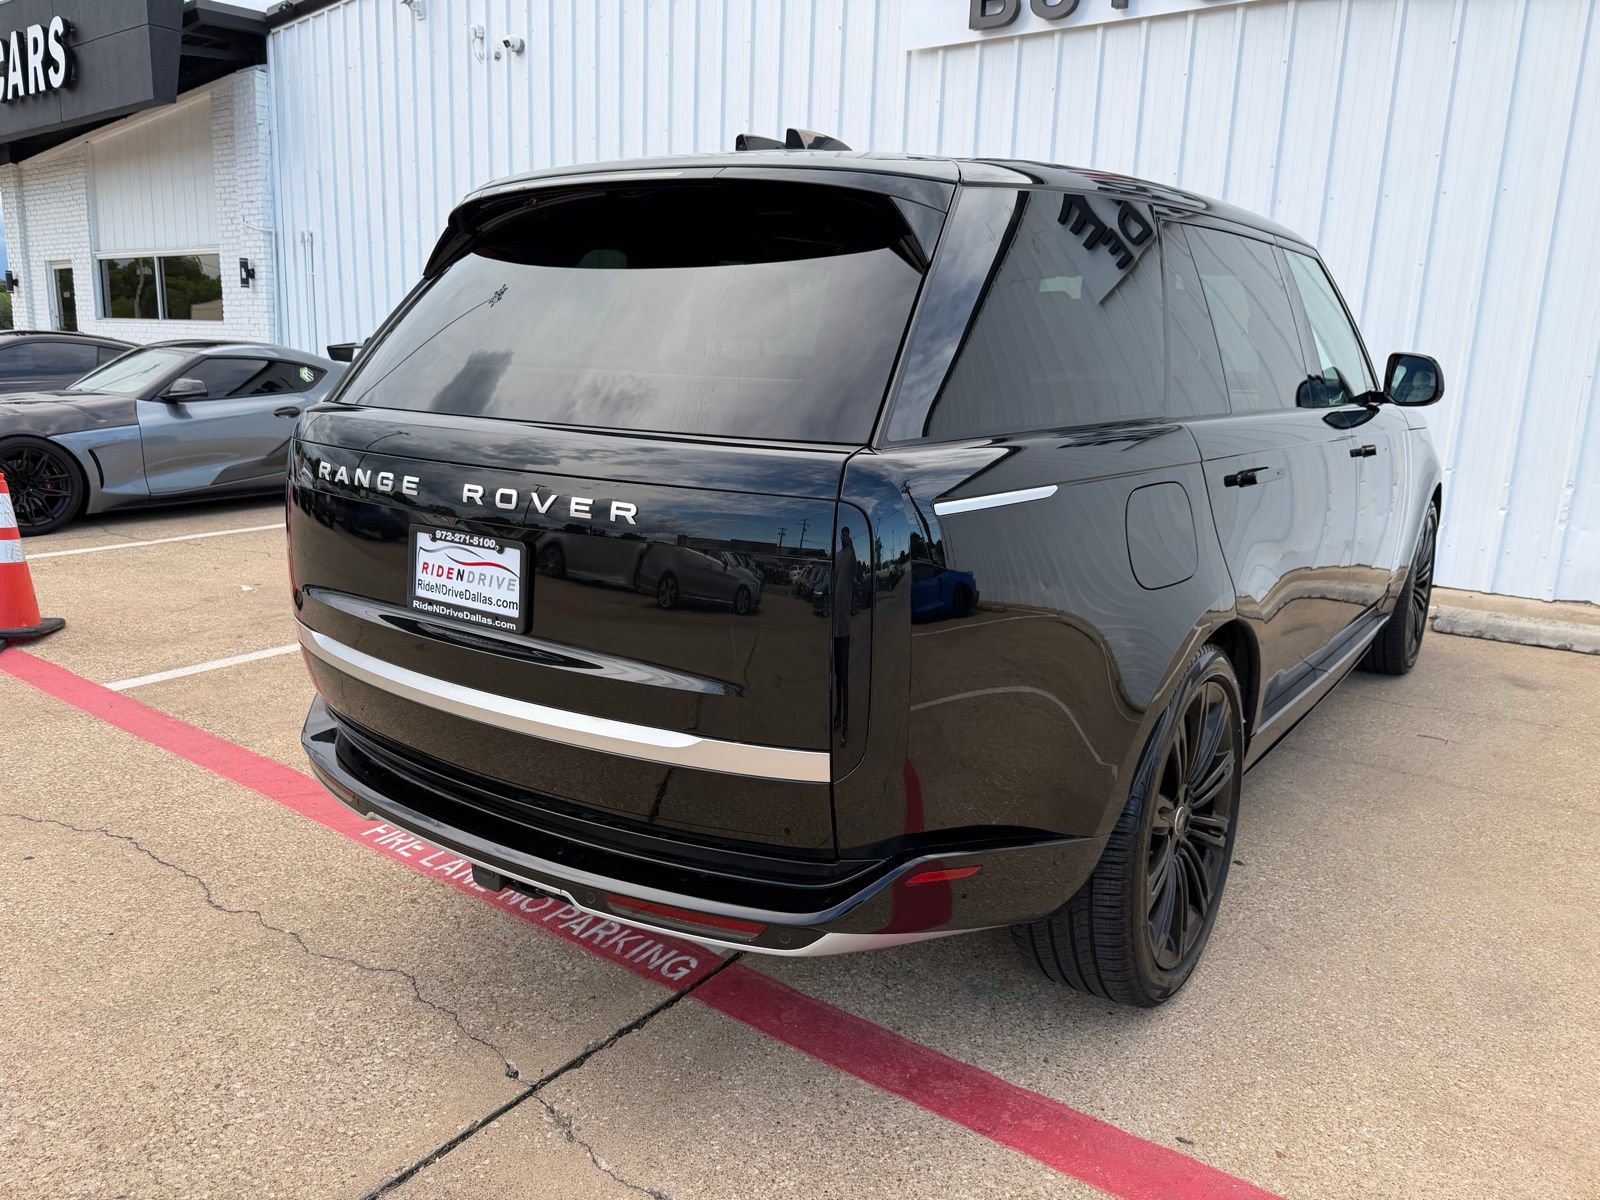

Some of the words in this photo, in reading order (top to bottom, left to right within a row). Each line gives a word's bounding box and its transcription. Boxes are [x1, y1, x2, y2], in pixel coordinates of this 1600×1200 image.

[0, 15, 67, 101] ARS
[318, 461, 420, 496] RANGE
[462, 483, 638, 525] ROVER
[435, 530, 496, 548] 972-271-5100
[421, 562, 517, 592] RIDENDRIVE
[417, 579, 519, 610] RideNDriveDallas.com
[412, 600, 517, 631] RideNDriveDallas.com
[360, 823, 425, 857] FIRE
[543, 904, 699, 981] PARKING
